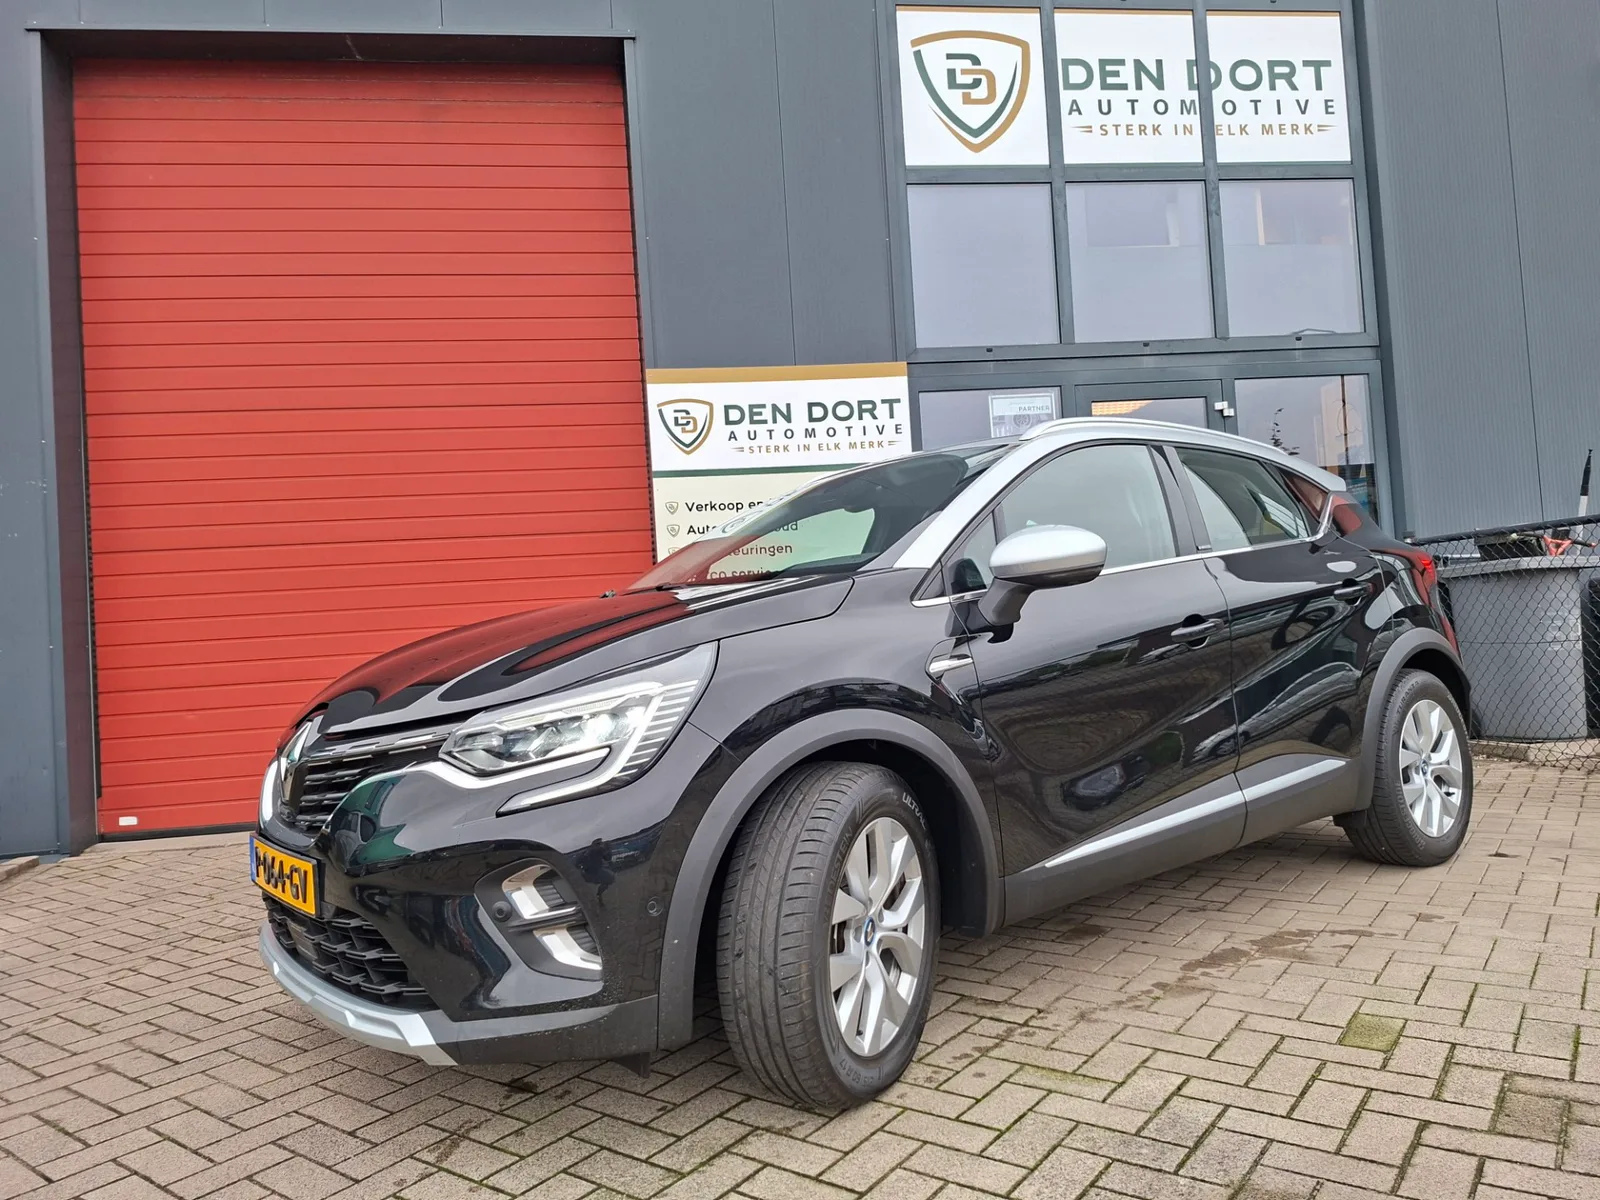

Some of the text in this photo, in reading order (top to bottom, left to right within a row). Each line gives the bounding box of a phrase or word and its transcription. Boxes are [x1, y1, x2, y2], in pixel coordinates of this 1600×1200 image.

[1061, 58, 1333, 92] DEN DORT
[1067, 98, 1337, 117] AUTOMOTIVE
[1099, 122, 1315, 137] STERK IN ELK MERK
[723, 398, 902, 426] DEN DORT
[727, 423, 904, 442] AUTOMOTIVE
[748, 440, 885, 454] STERK IN ELK MERK
[685, 501, 744, 513] Verkoop
[728, 543, 794, 557] euringen
